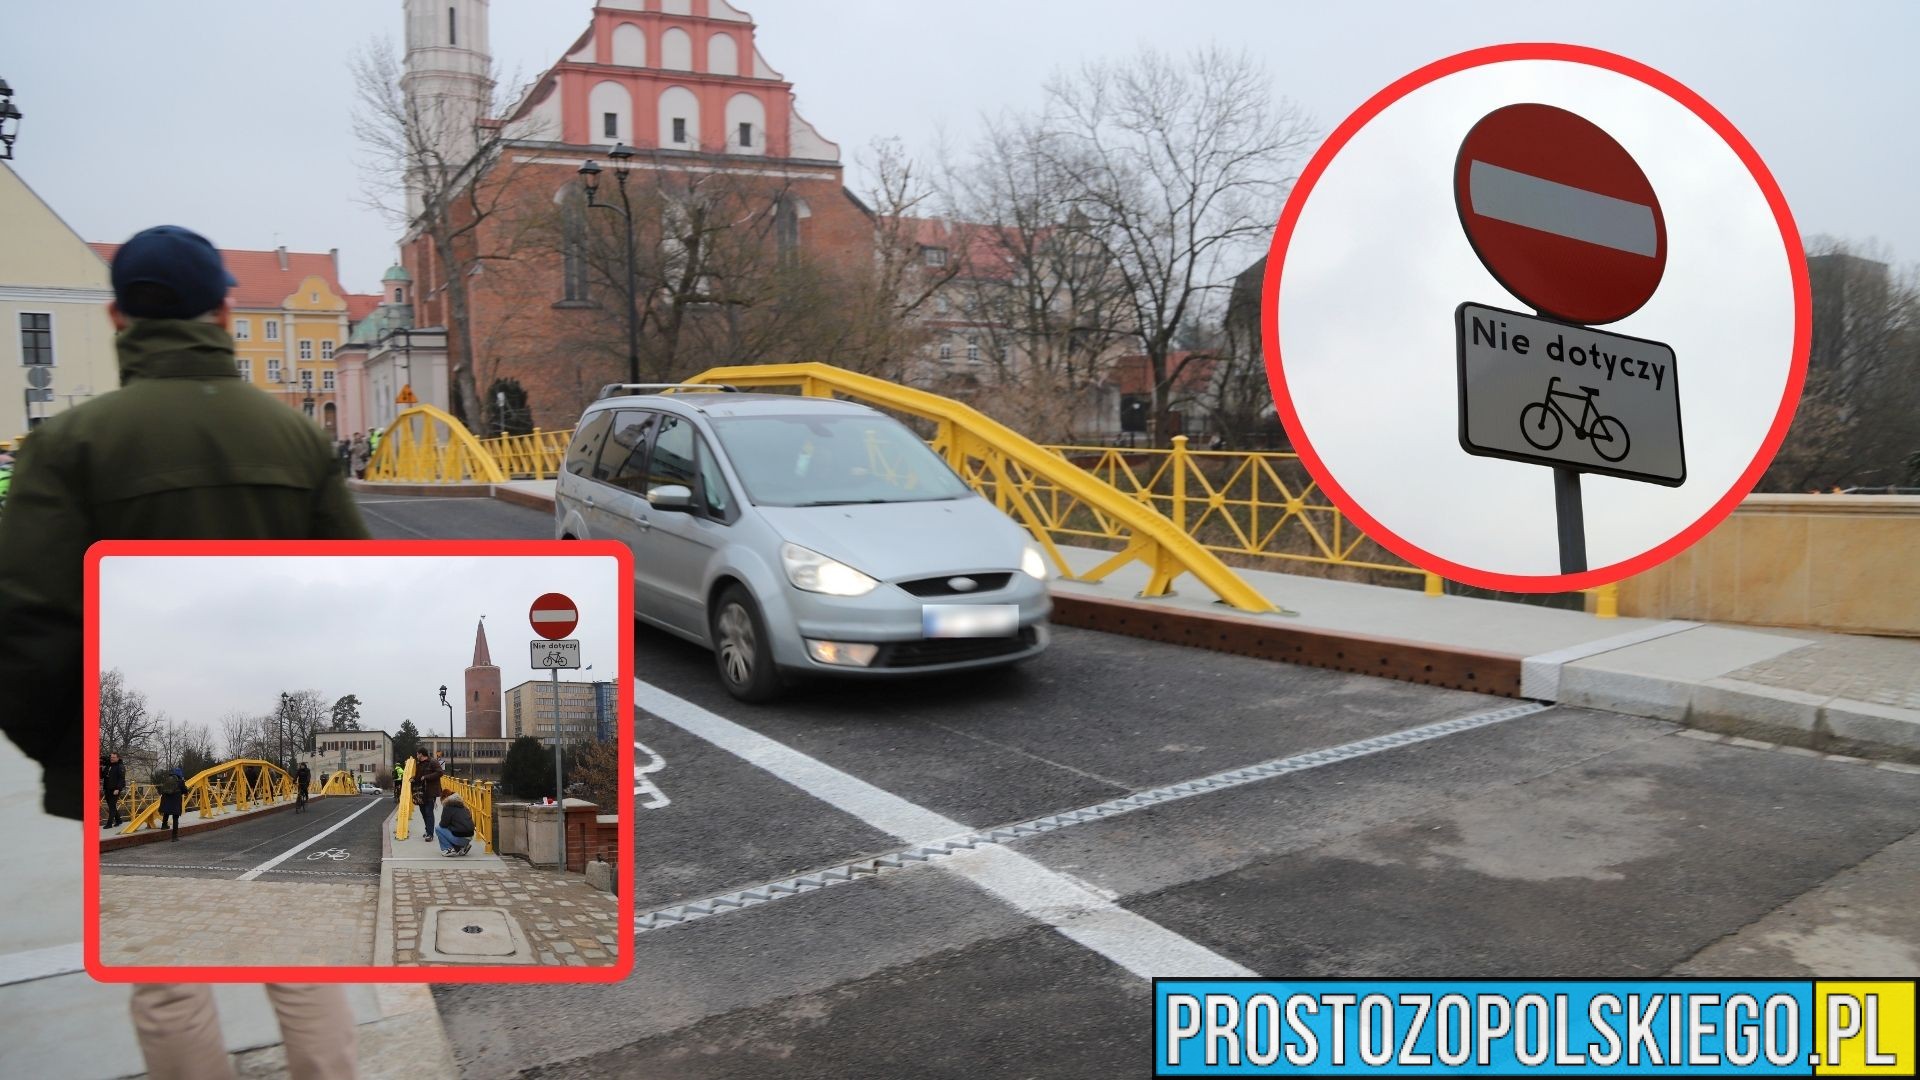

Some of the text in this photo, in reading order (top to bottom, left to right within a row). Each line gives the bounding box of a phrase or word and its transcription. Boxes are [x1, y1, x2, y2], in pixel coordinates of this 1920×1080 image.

[1472, 316, 1665, 391] Nie dotyczy
[548, 642, 577, 650] dotyczy
